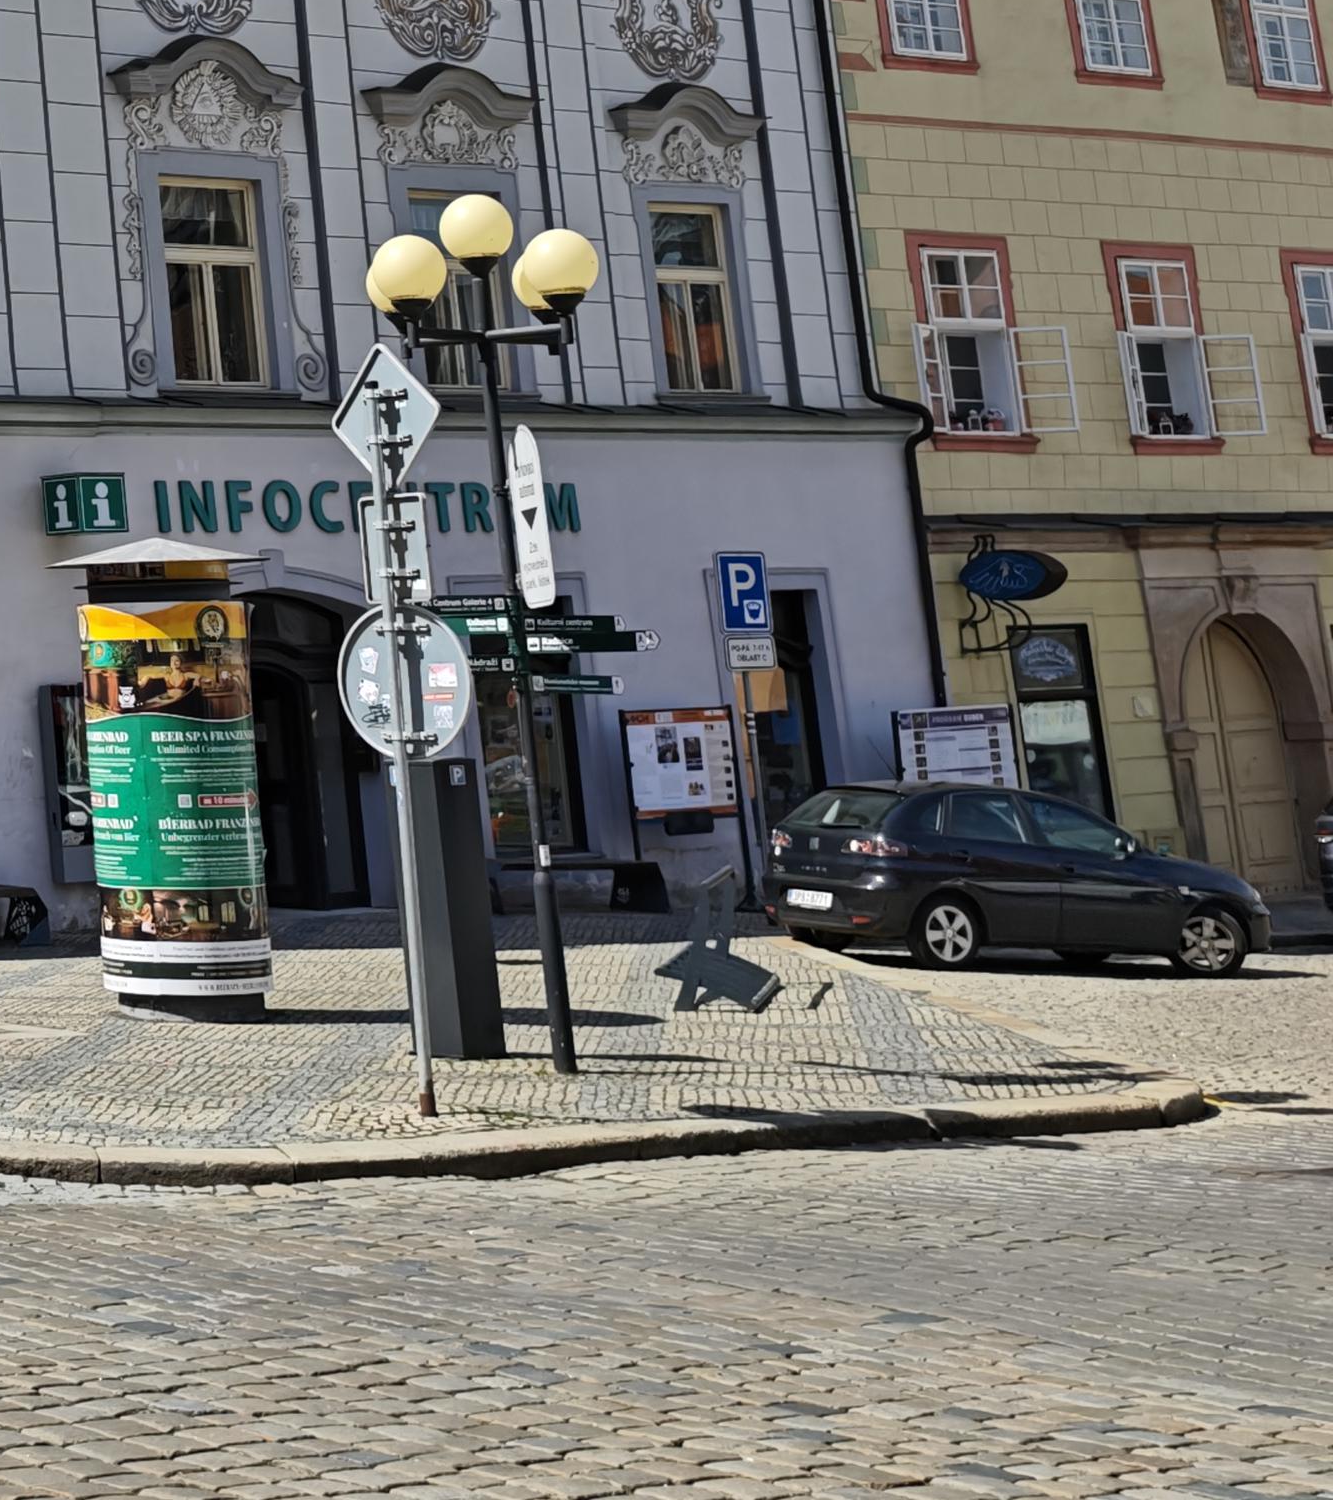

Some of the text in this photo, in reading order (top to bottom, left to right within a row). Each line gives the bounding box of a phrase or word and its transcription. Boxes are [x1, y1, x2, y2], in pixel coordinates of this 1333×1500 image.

[153, 480, 582, 534] INFOCTRM
[728, 563, 756, 607] P
[150, 731, 184, 742] BEER
[185, 730, 209, 742] SPA
[156, 743, 201, 755] Unlimited
[158, 817, 213, 830] BIERBAD
